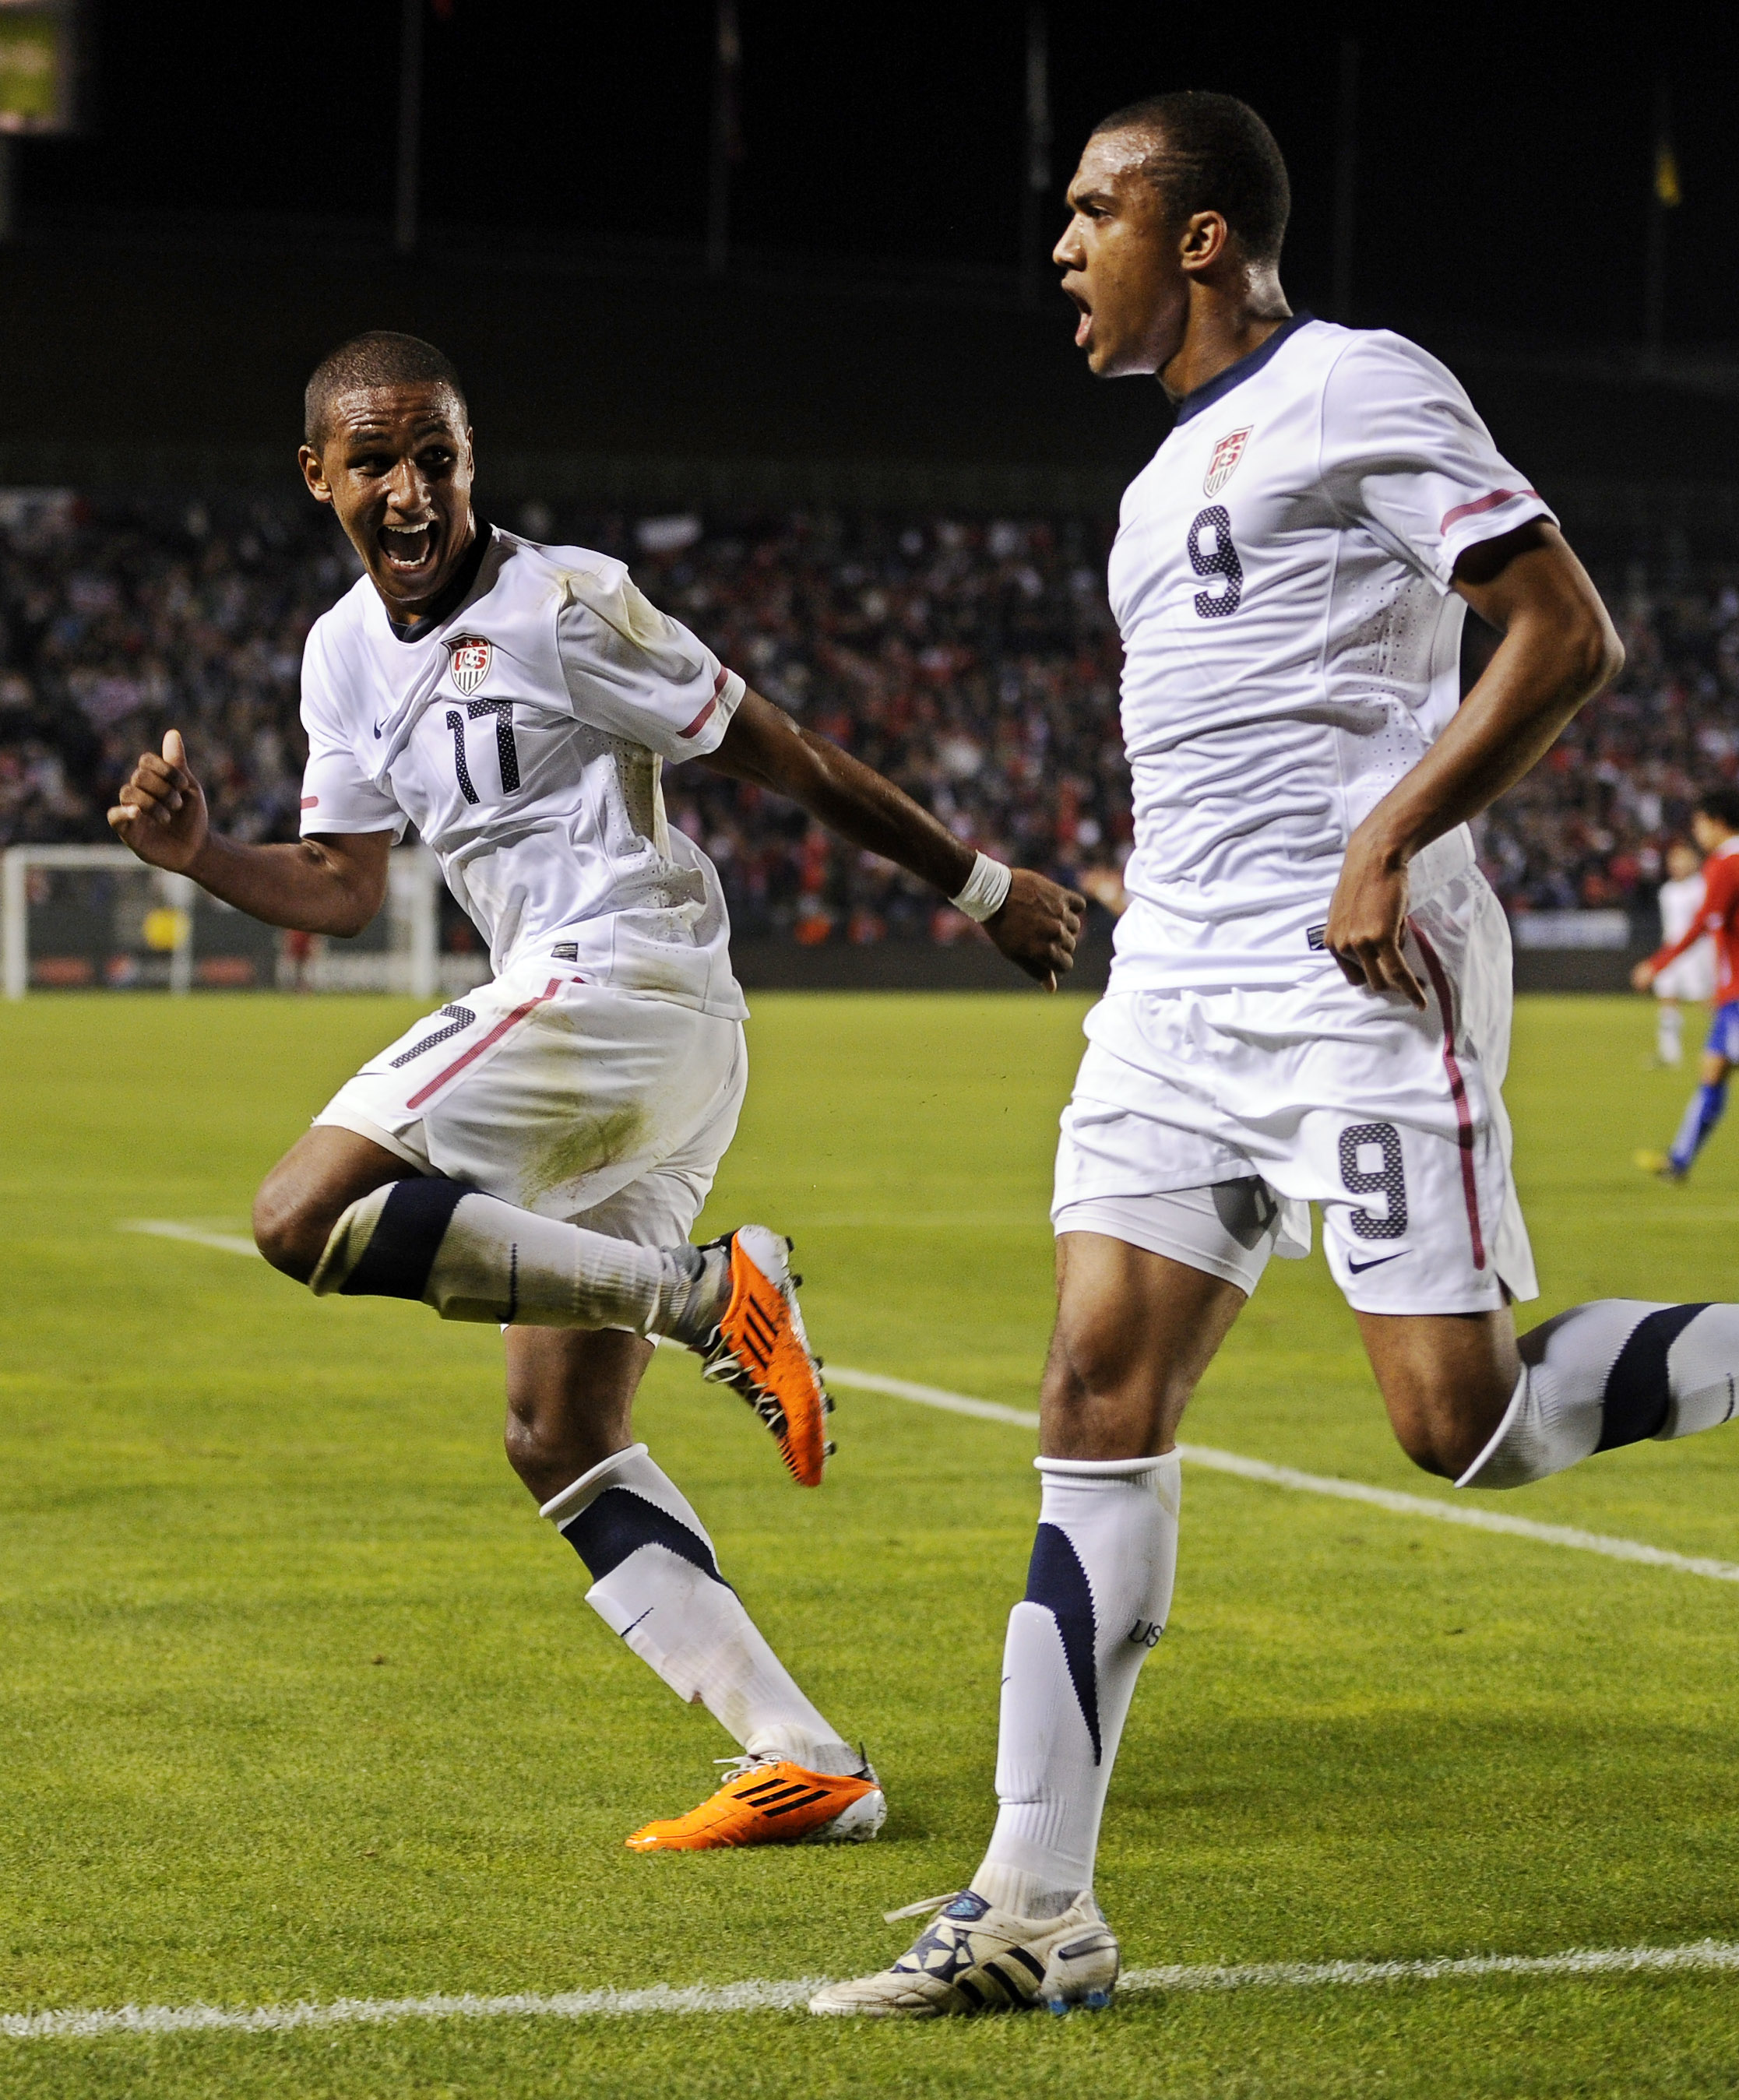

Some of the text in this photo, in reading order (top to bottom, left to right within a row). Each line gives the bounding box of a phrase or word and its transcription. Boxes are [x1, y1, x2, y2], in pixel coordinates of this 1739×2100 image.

[1187, 505, 1244, 619] 9
[445, 698, 520, 805] 17
[1338, 1122, 1408, 1240] 9
